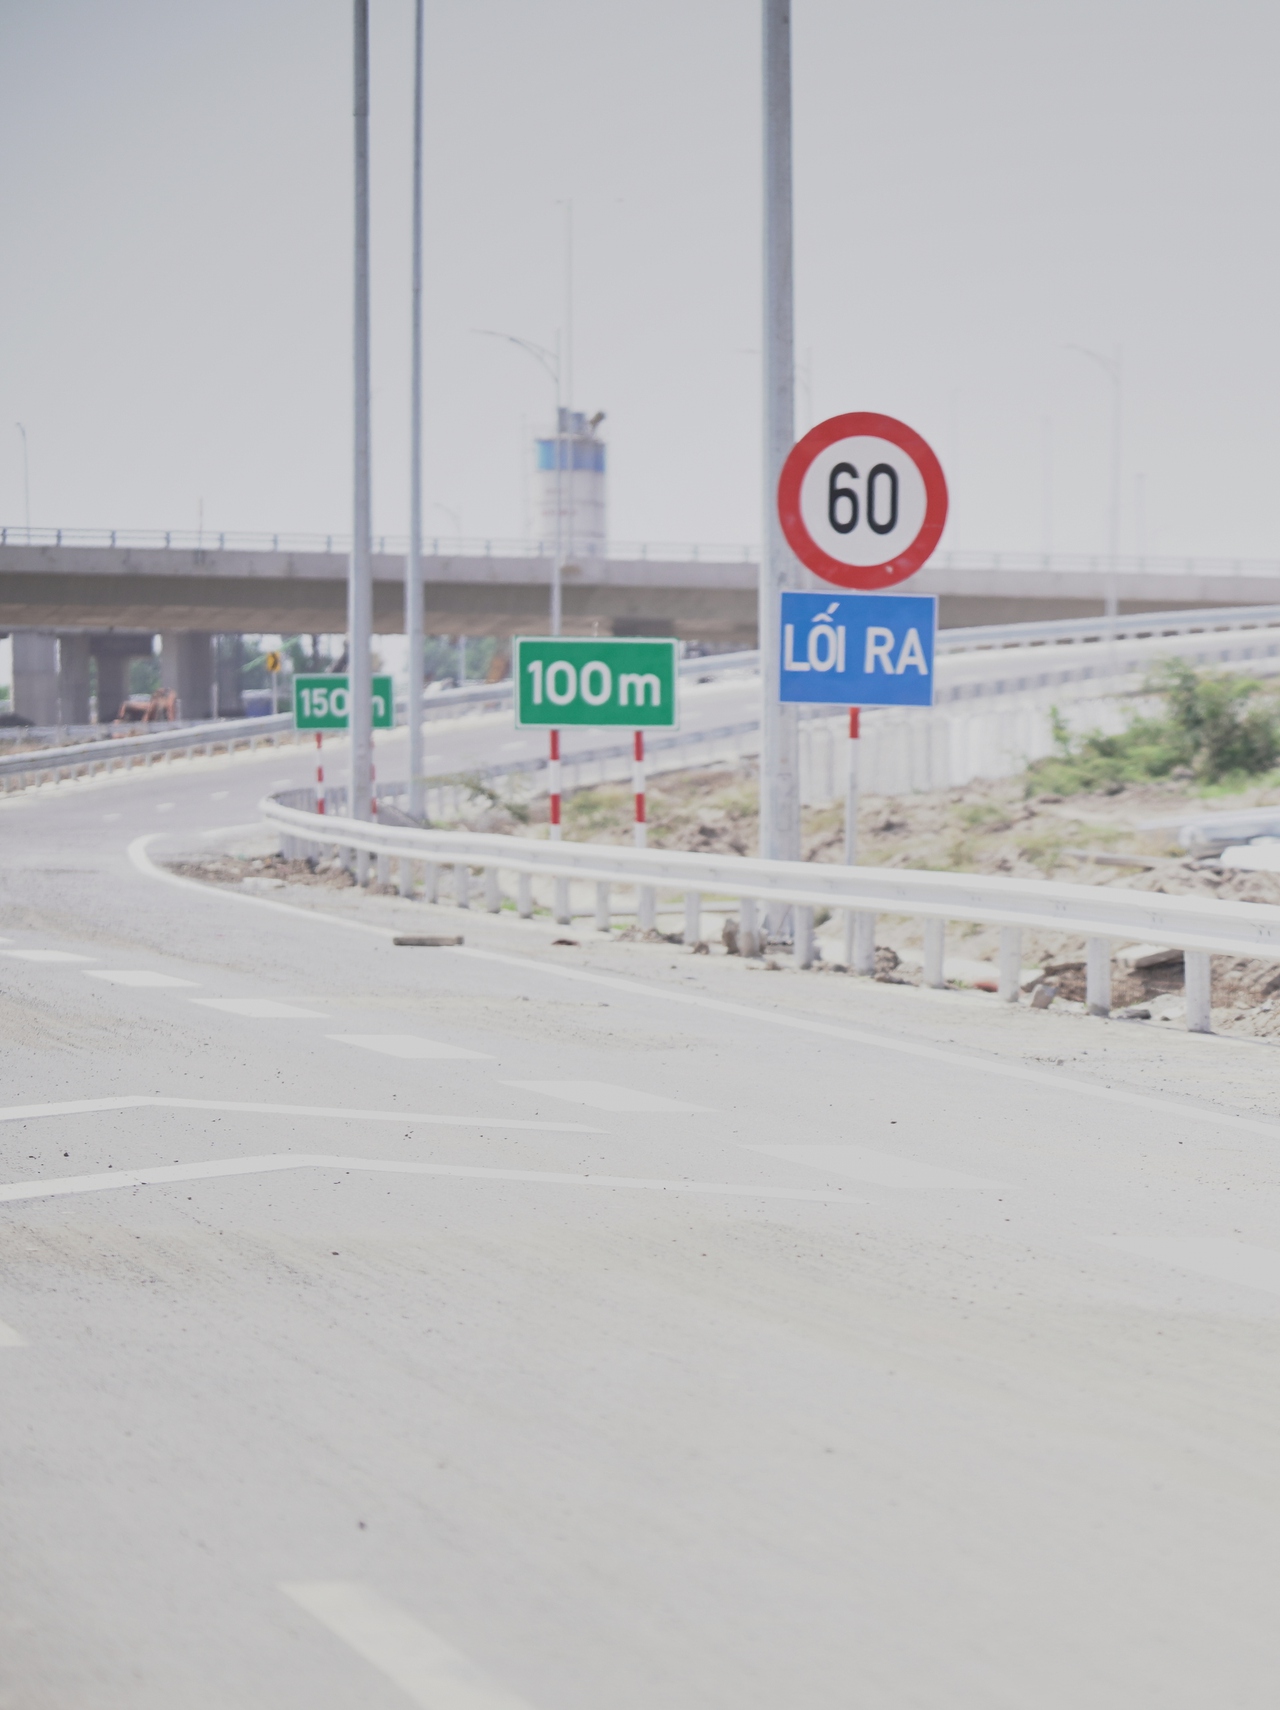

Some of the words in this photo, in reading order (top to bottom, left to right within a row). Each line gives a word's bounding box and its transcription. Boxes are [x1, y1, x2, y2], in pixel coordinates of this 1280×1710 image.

[828, 461, 898, 535] 60
[784, 602, 846, 673] LỐI
[864, 626, 929, 675] RA
